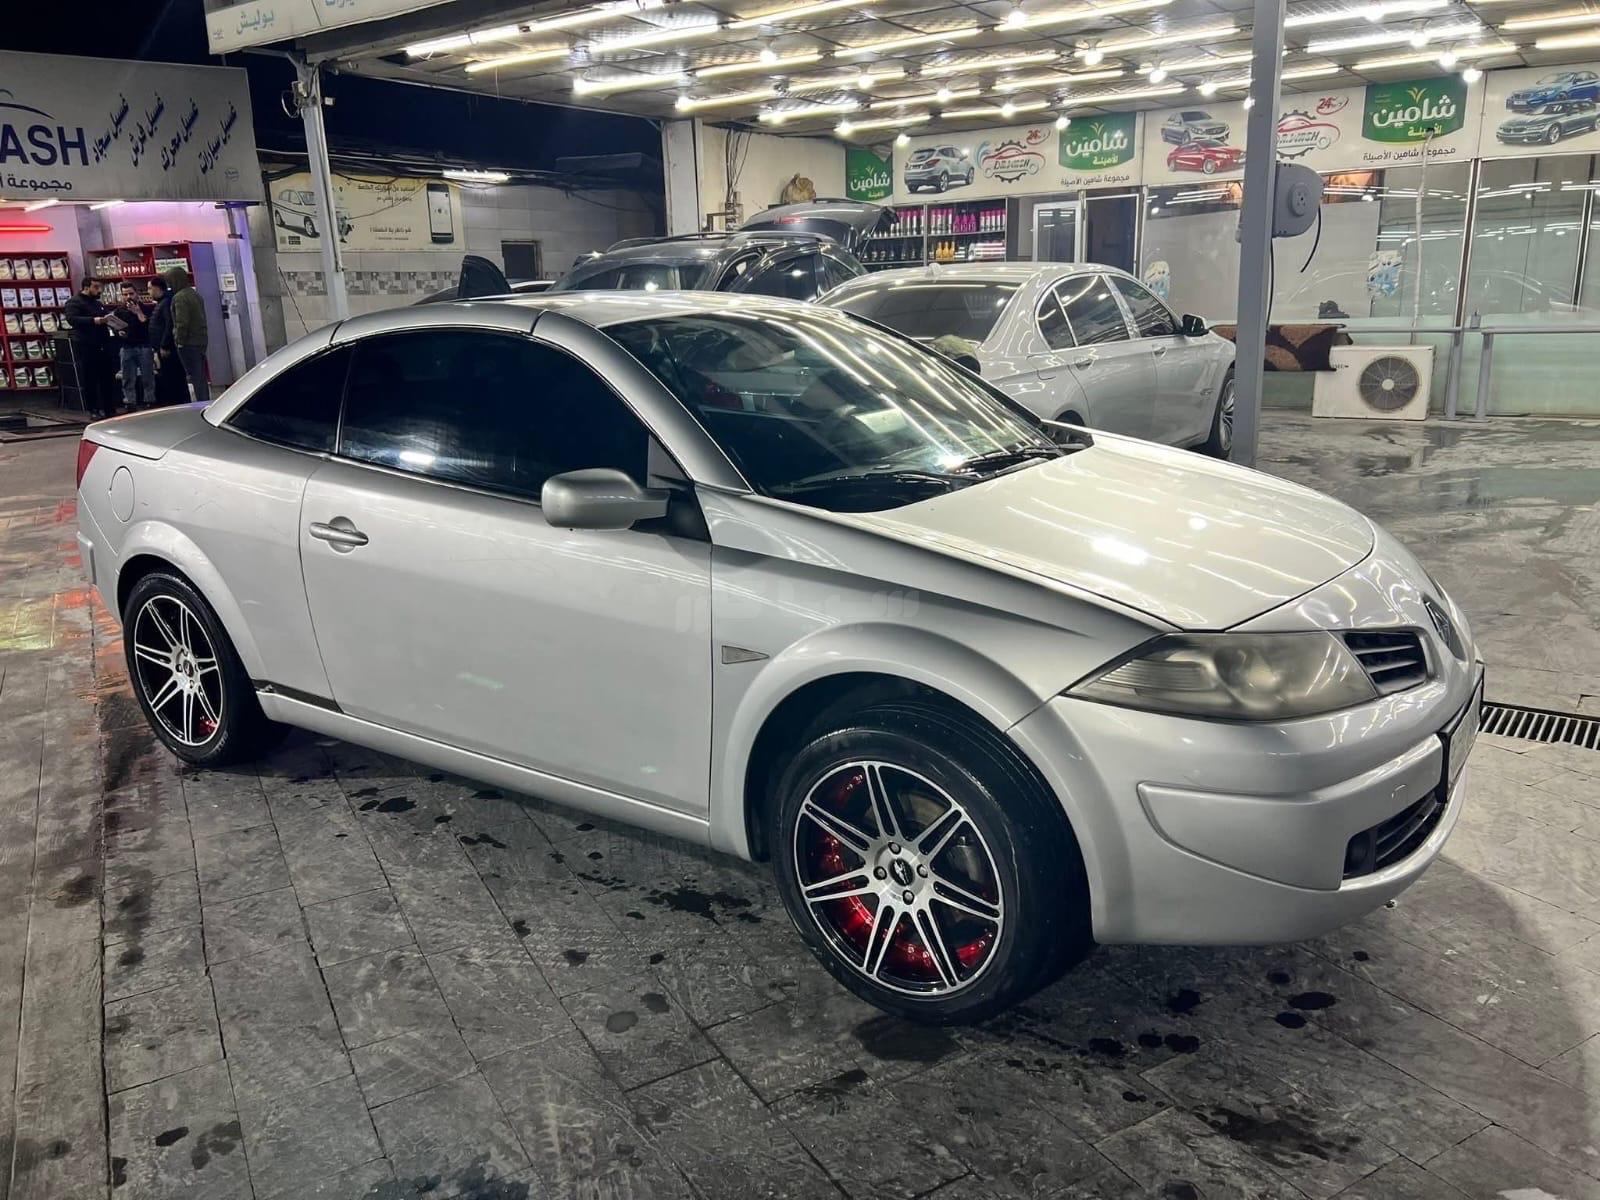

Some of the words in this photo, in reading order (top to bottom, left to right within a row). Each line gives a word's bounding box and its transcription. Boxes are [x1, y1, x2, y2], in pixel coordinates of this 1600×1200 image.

[236, 9, 274, 35] بوليش
[0, 124, 89, 166] ASH
[1393, 148, 1419, 160] شامين
[1363, 150, 1391, 162] الأصيلة
[8, 173, 73, 192] مجموعة
